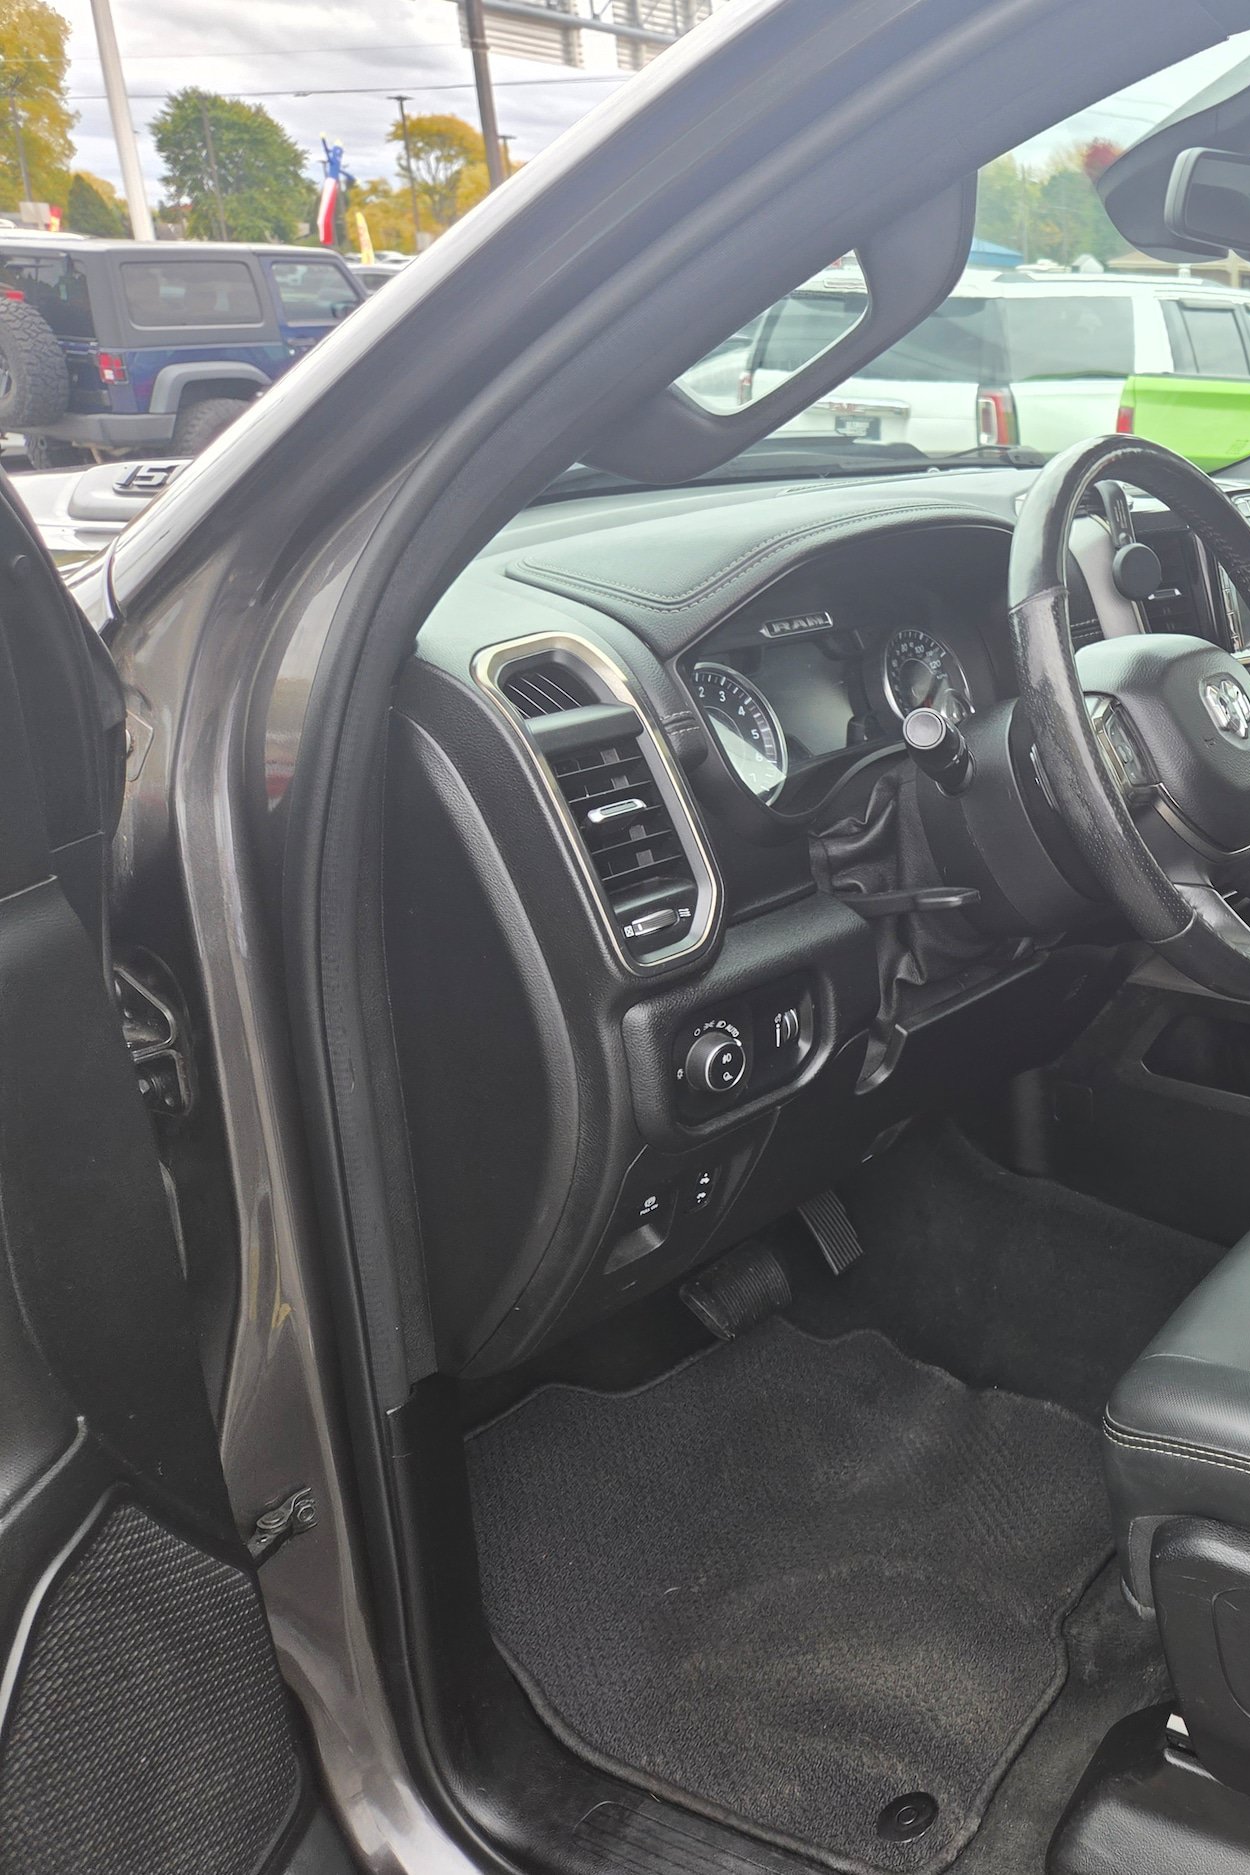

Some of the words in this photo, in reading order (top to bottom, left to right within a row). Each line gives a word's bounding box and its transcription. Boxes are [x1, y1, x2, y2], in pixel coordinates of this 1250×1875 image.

[772, 615, 824, 633] RAM
[914, 644, 925, 654] 100
[929, 659, 942, 669] 120
[698, 686, 705, 698] 2
[719, 691, 726, 702] 3
[738, 706, 746, 716] 4
[751, 729, 760, 739] 5
